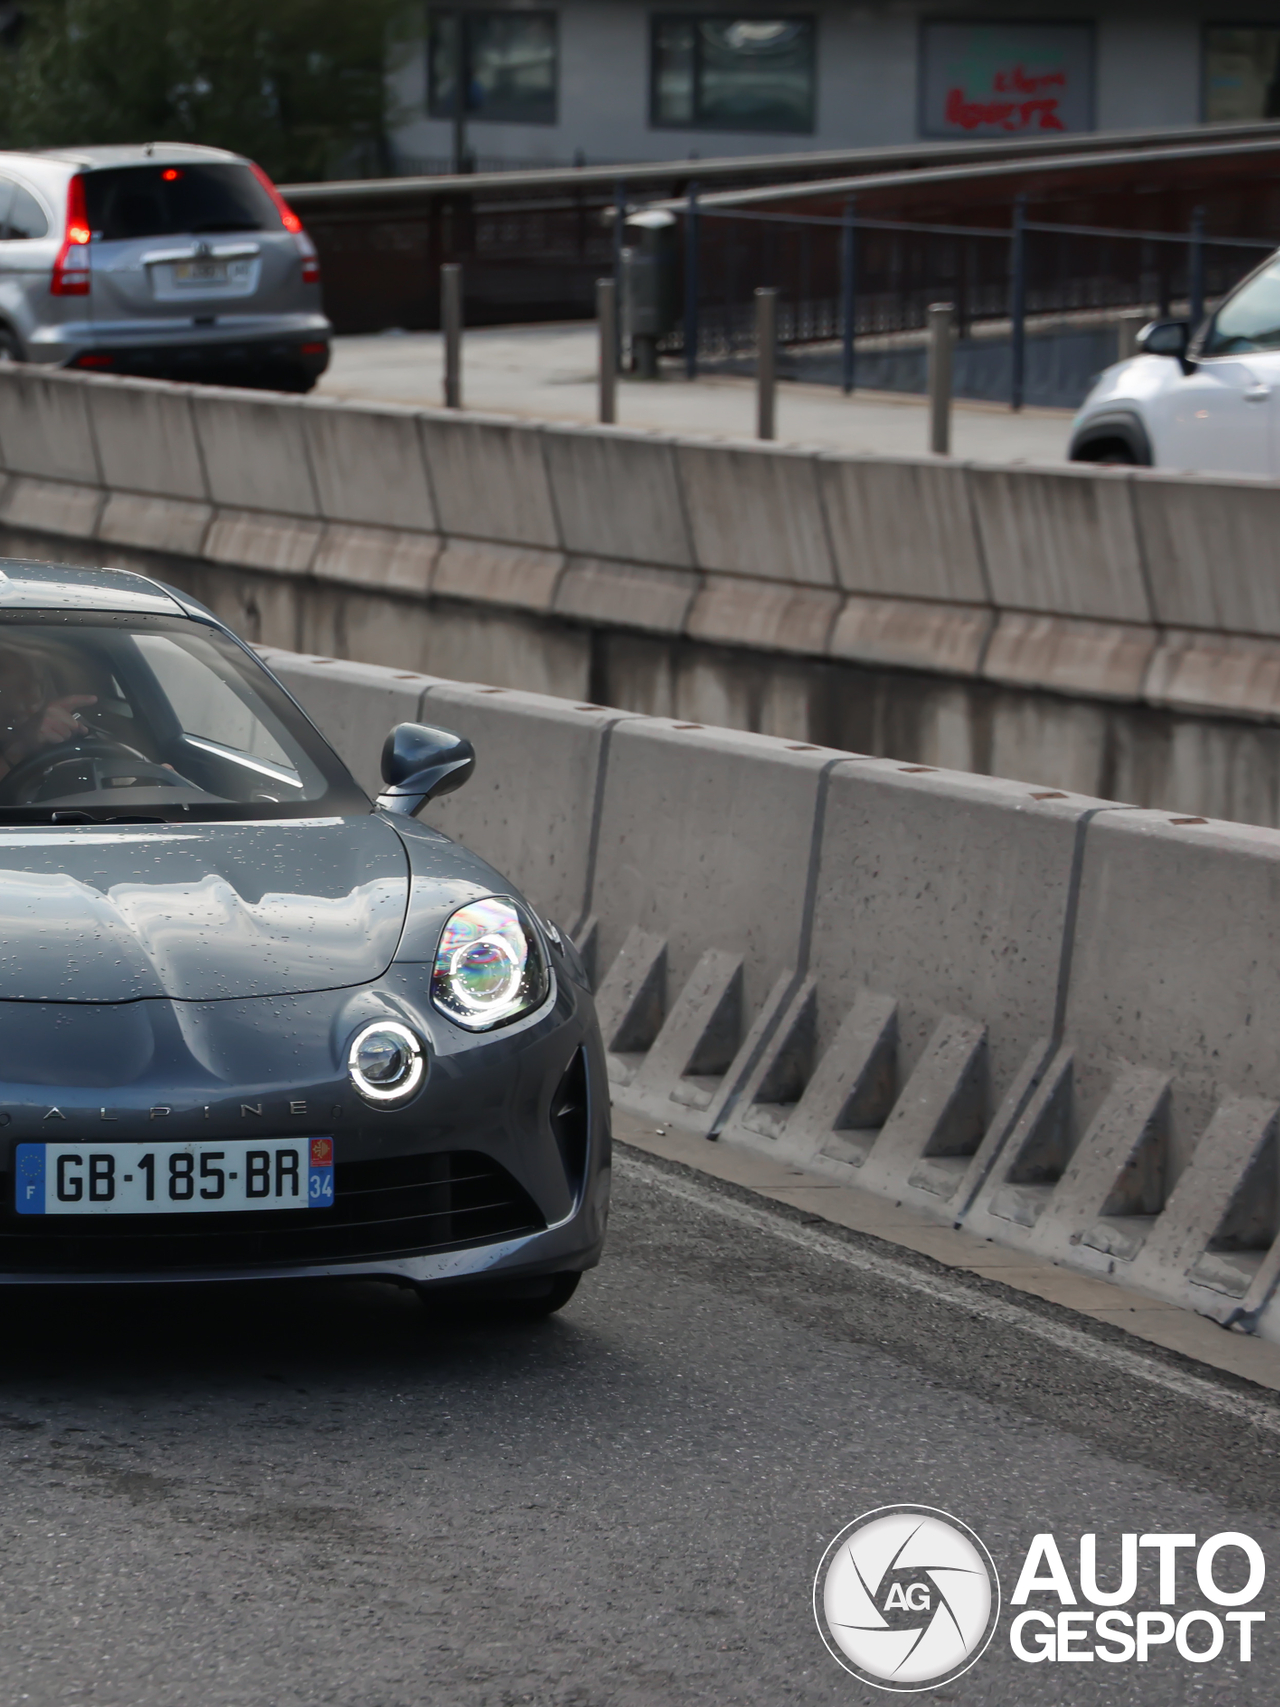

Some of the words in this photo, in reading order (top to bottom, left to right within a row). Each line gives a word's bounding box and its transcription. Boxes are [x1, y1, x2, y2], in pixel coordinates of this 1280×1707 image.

[43, 1100, 308, 1121] ALPINE
[56, 1148, 300, 1203] GB-185-BR
[309, 1174, 333, 1199] 34
[26, 1185, 37, 1200] F
